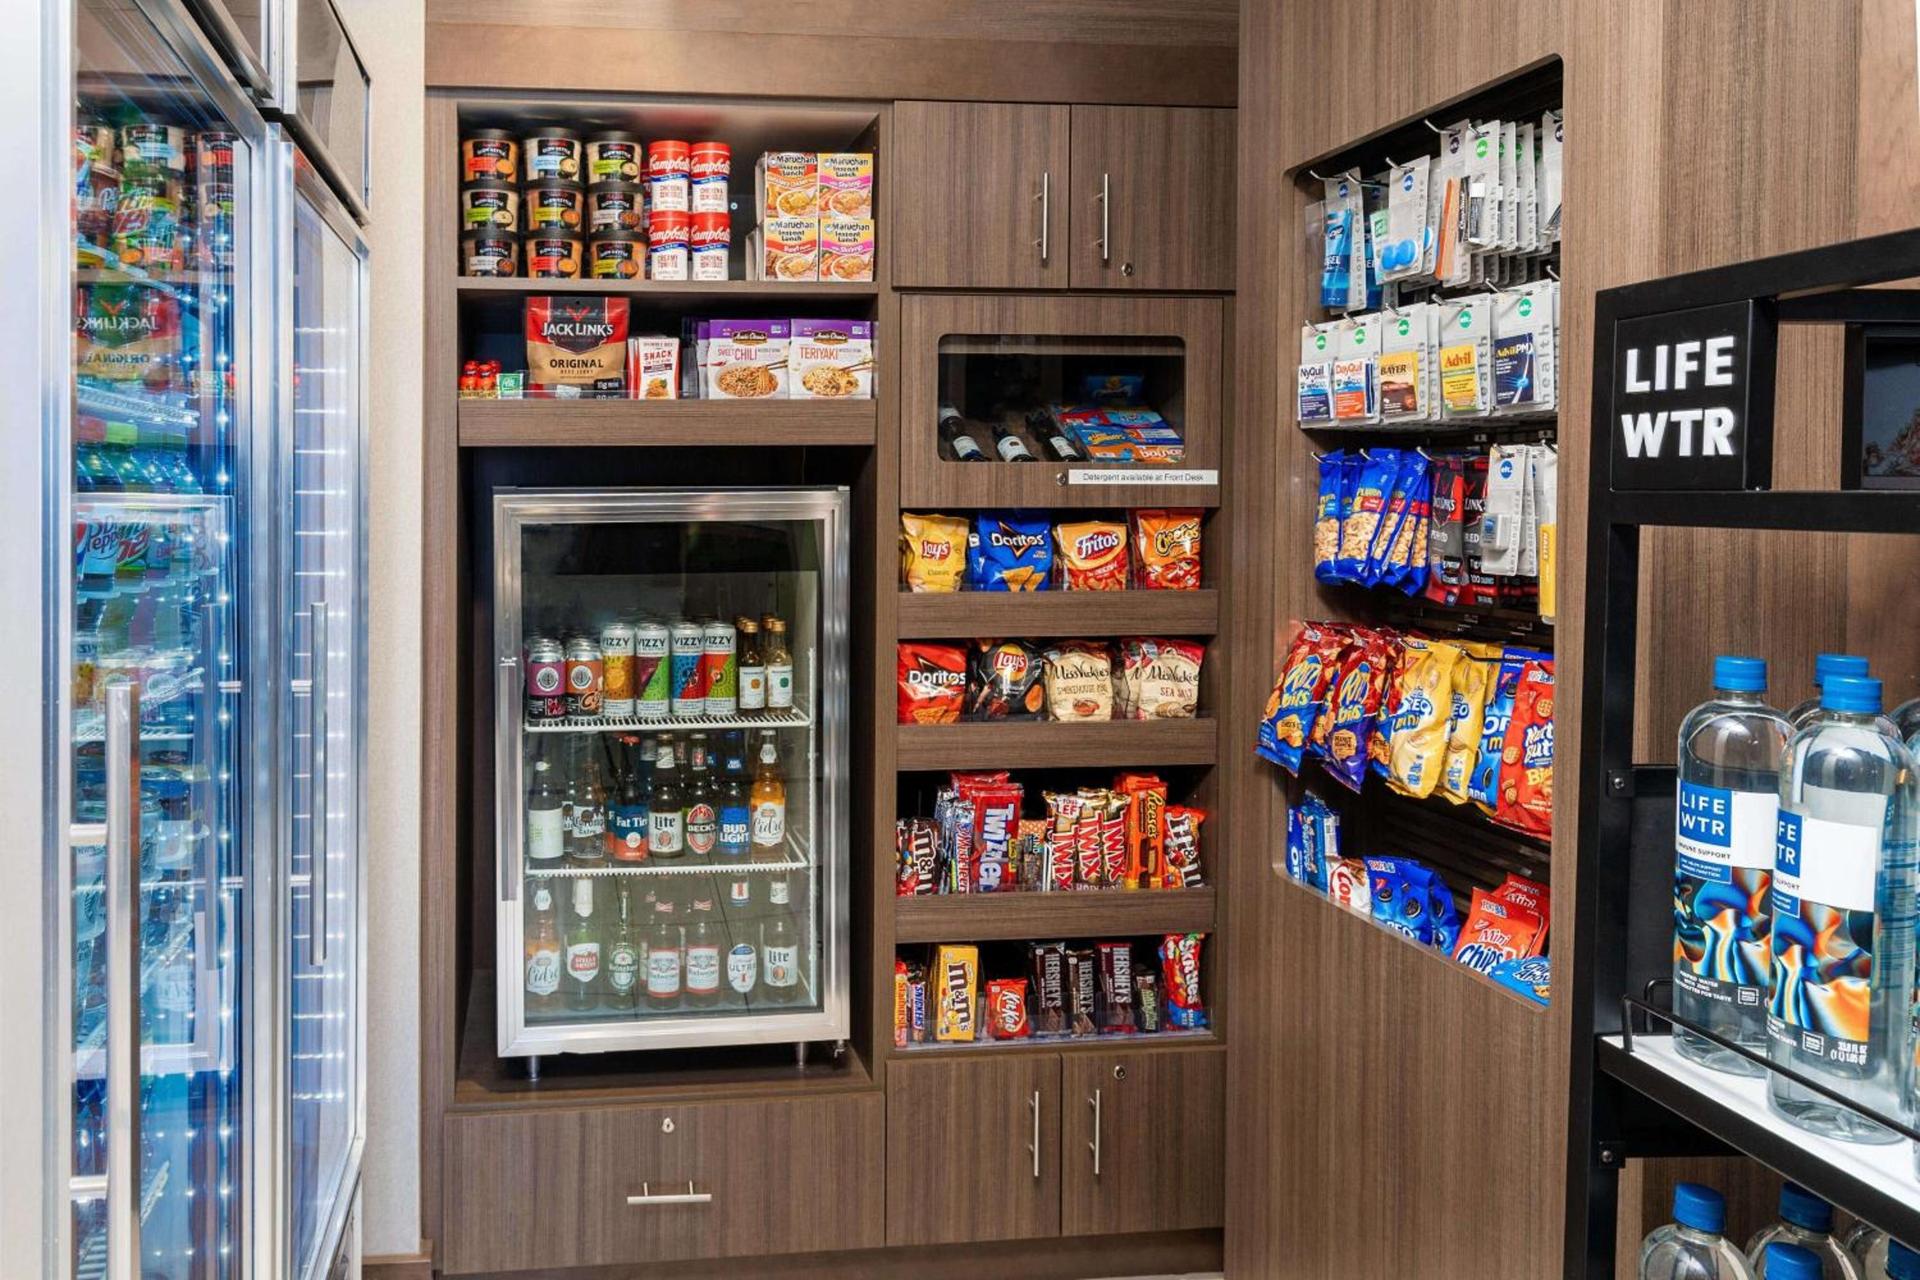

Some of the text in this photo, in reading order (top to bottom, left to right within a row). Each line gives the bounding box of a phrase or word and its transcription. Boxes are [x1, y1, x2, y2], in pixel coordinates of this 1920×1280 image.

[777, 156, 816, 164] Maruchan
[830, 158, 869, 166] Maruchan
[775, 221, 815, 229] Maruchan
[832, 223, 870, 231] Maruchan
[542, 322, 575, 336] JACK
[644, 350, 673, 360] SNACK
[734, 349, 757, 361] CHILI
[800, 347, 838, 360] TERIYAKI
[1445, 351, 1472, 368] Advil
[550, 359, 604, 369] ORIGINAL
[1380, 365, 1407, 376] BAYER
[1538, 324, 1550, 404] health
[1625, 335, 1735, 393] LIFE
[1300, 366, 1325, 380] NyQuil
[1621, 407, 1736, 458] WTR
[1083, 473, 1119, 481] Detergent
[991, 532, 1044, 547] Doritos
[1075, 532, 1119, 559] Fritos
[1155, 521, 1200, 557] Cheetos
[922, 541, 949, 560] Lay's
[909, 670, 966, 685] Doritos
[1160, 688, 1175, 697] SEA
[1682, 791, 1726, 815] LIFE
[617, 817, 631, 827] Fat
[654, 815, 676, 829] Lite
[723, 823, 747, 833] BUD
[1681, 811, 1726, 836] WTR
[720, 832, 749, 842] LIGHT
[1079, 810, 1104, 880] TWIX
[1102, 810, 1127, 882] TWIX
[1052, 825, 1079, 890] TWIX
[1697, 848, 1731, 860] SUPPORT
[1479, 929, 1512, 946] Mini
[769, 950, 790, 965] Lite
[1457, 943, 1504, 976] Chips
[1045, 953, 1062, 1008] HERSHEY'S
[1112, 947, 1132, 1004] HERSHEY'S
[1079, 960, 1095, 1014] HERSHEY'S
